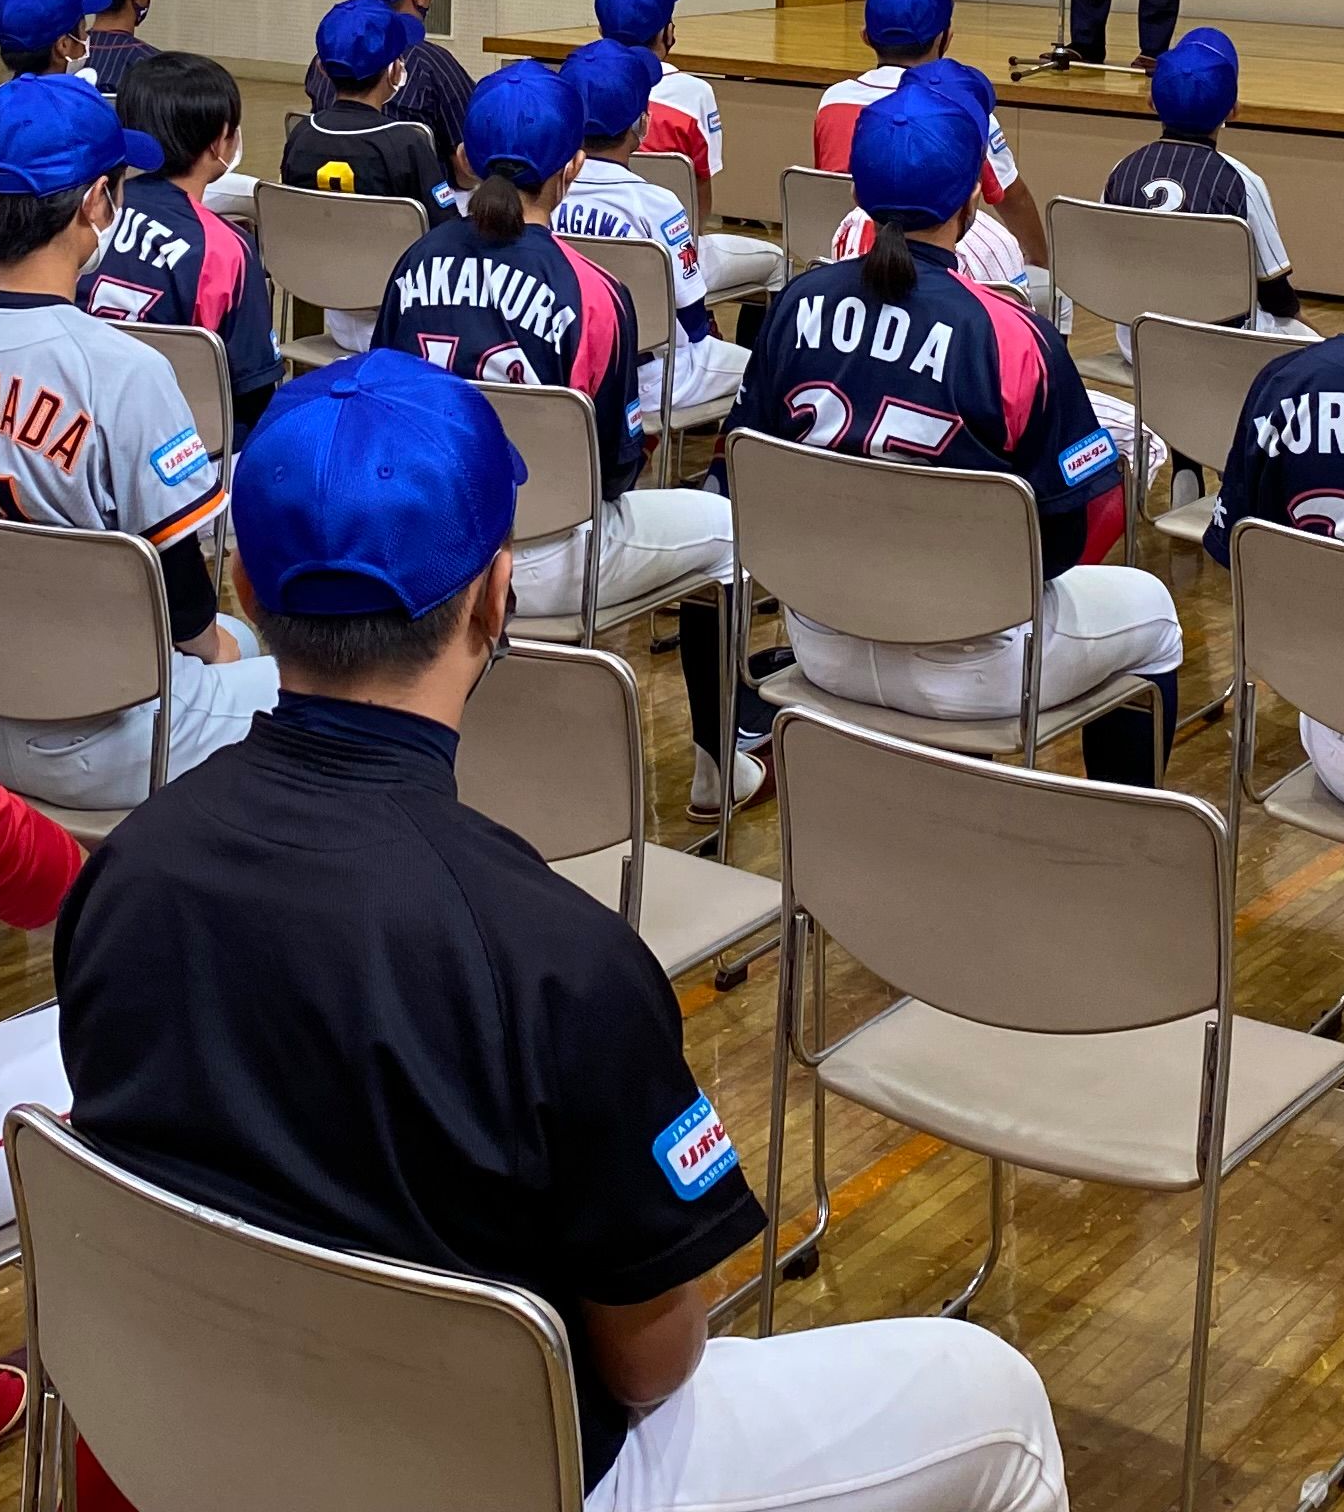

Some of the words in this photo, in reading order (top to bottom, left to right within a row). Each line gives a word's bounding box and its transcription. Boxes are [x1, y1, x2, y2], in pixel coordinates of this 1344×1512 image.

[551, 203, 631, 238] AGAWA
[395, 256, 577, 355] NAKAMURA
[796, 295, 953, 383] NODA
[1067, 443, 1108, 471] リポビタン
[672, 1103, 709, 1142] JAPAN
